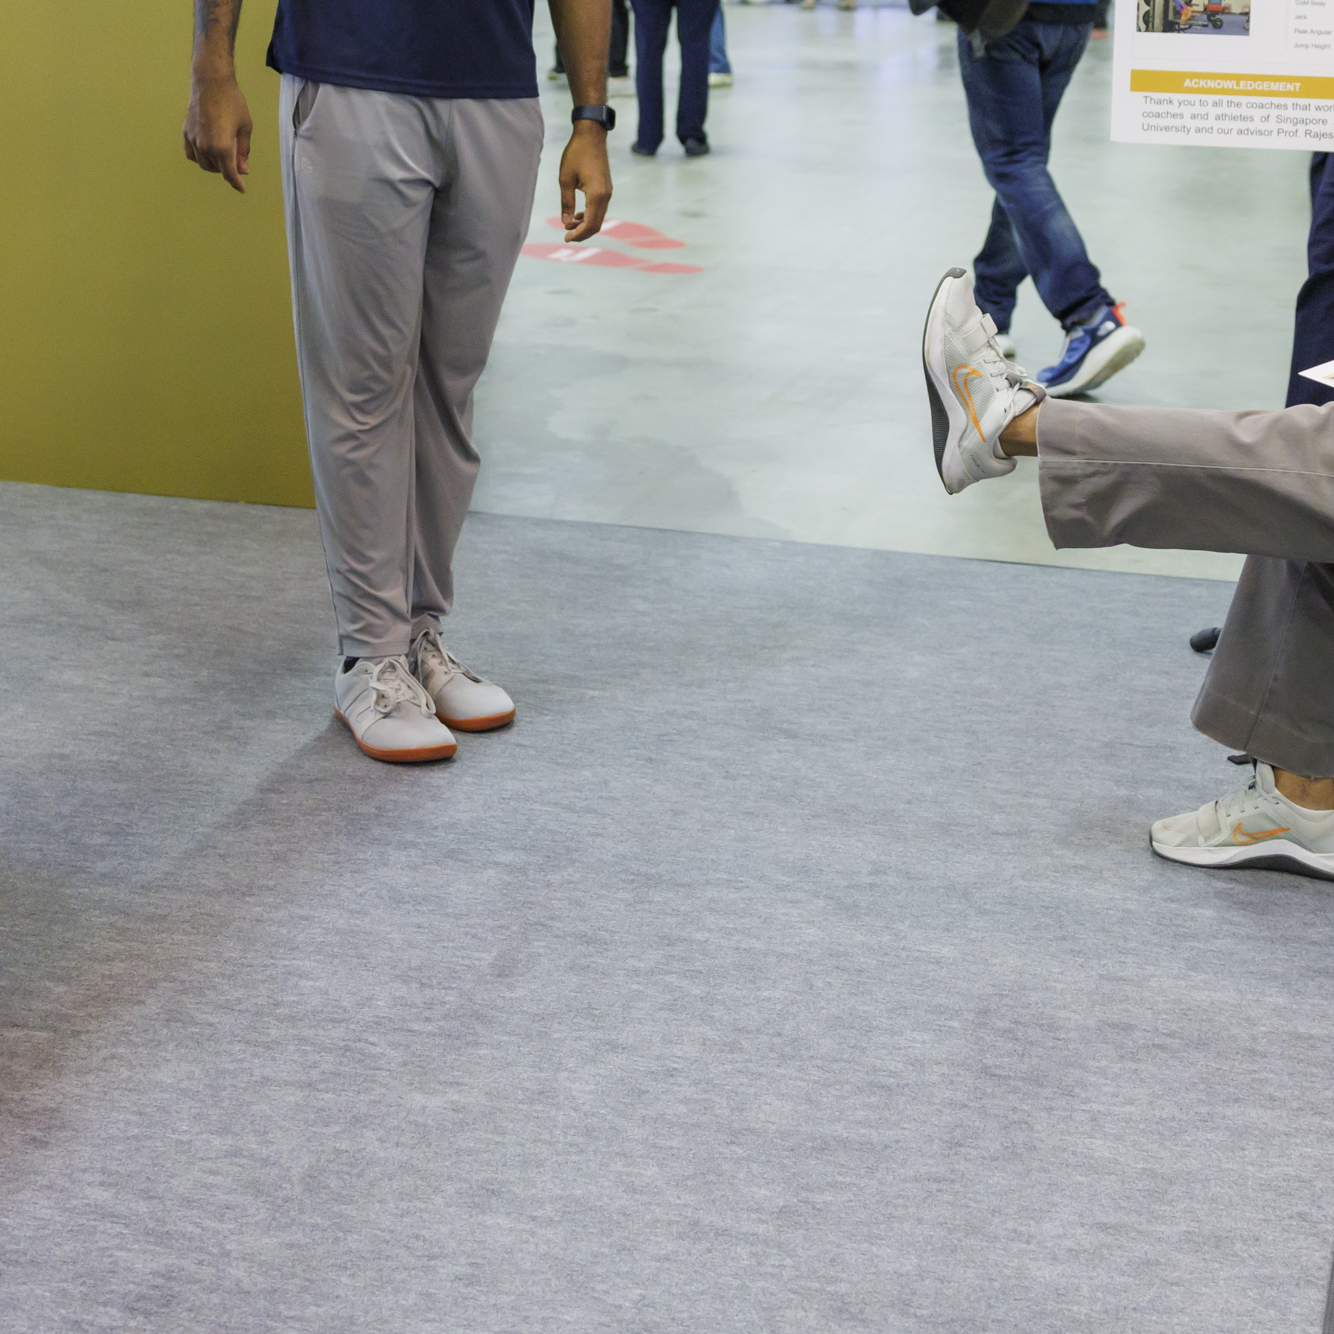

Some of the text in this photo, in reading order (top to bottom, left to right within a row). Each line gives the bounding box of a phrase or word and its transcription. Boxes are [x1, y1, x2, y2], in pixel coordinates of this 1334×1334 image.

[1183, 78, 1302, 92] ACKNOWLEDGEMENT
[1142, 109, 1184, 120] coaches
[1190, 111, 1209, 121] and
[1214, 112, 1255, 123] athletes
[1260, 114, 1271, 123] of
[1275, 114, 1328, 127] Singapore
